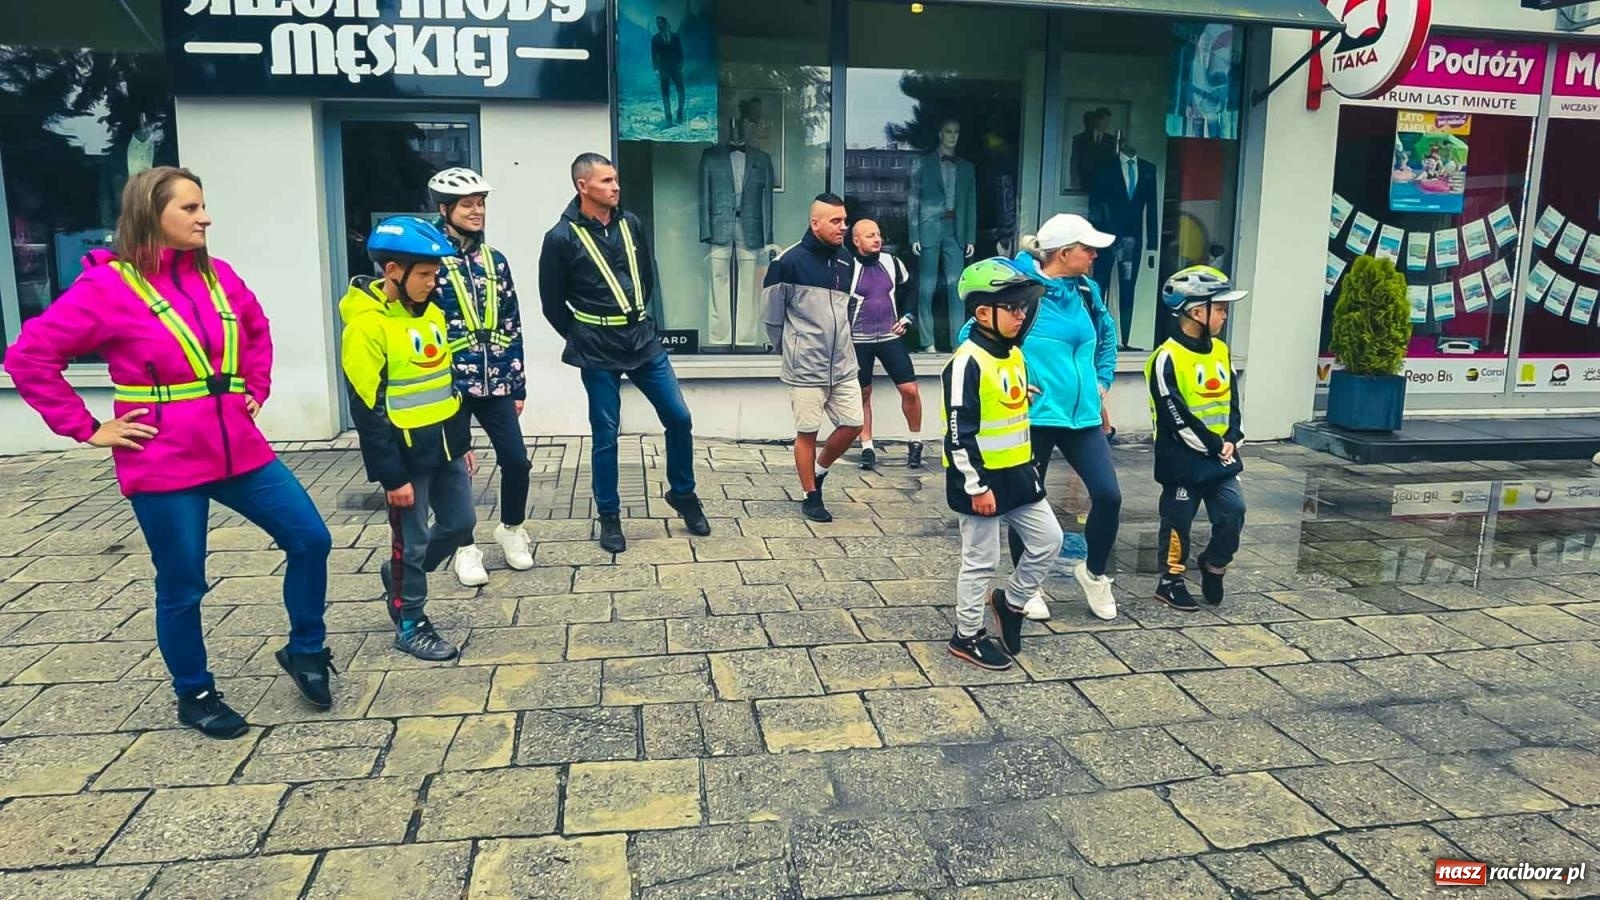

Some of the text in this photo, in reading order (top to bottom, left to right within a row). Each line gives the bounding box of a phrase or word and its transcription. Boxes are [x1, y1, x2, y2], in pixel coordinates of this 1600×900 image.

[270, 23, 509, 87] MĘSKIEJ
[1332, 48, 1378, 73] ITAKA
[1427, 45, 1535, 85] Podróży
[1427, 94, 1458, 106] LAST
[1462, 96, 1517, 109] MINUTE
[1561, 104, 1598, 112] WCZASY
[658, 336, 688, 344] ARD
[1405, 370, 1453, 384] Rego Bis
[1481, 368, 1504, 376] Coral
